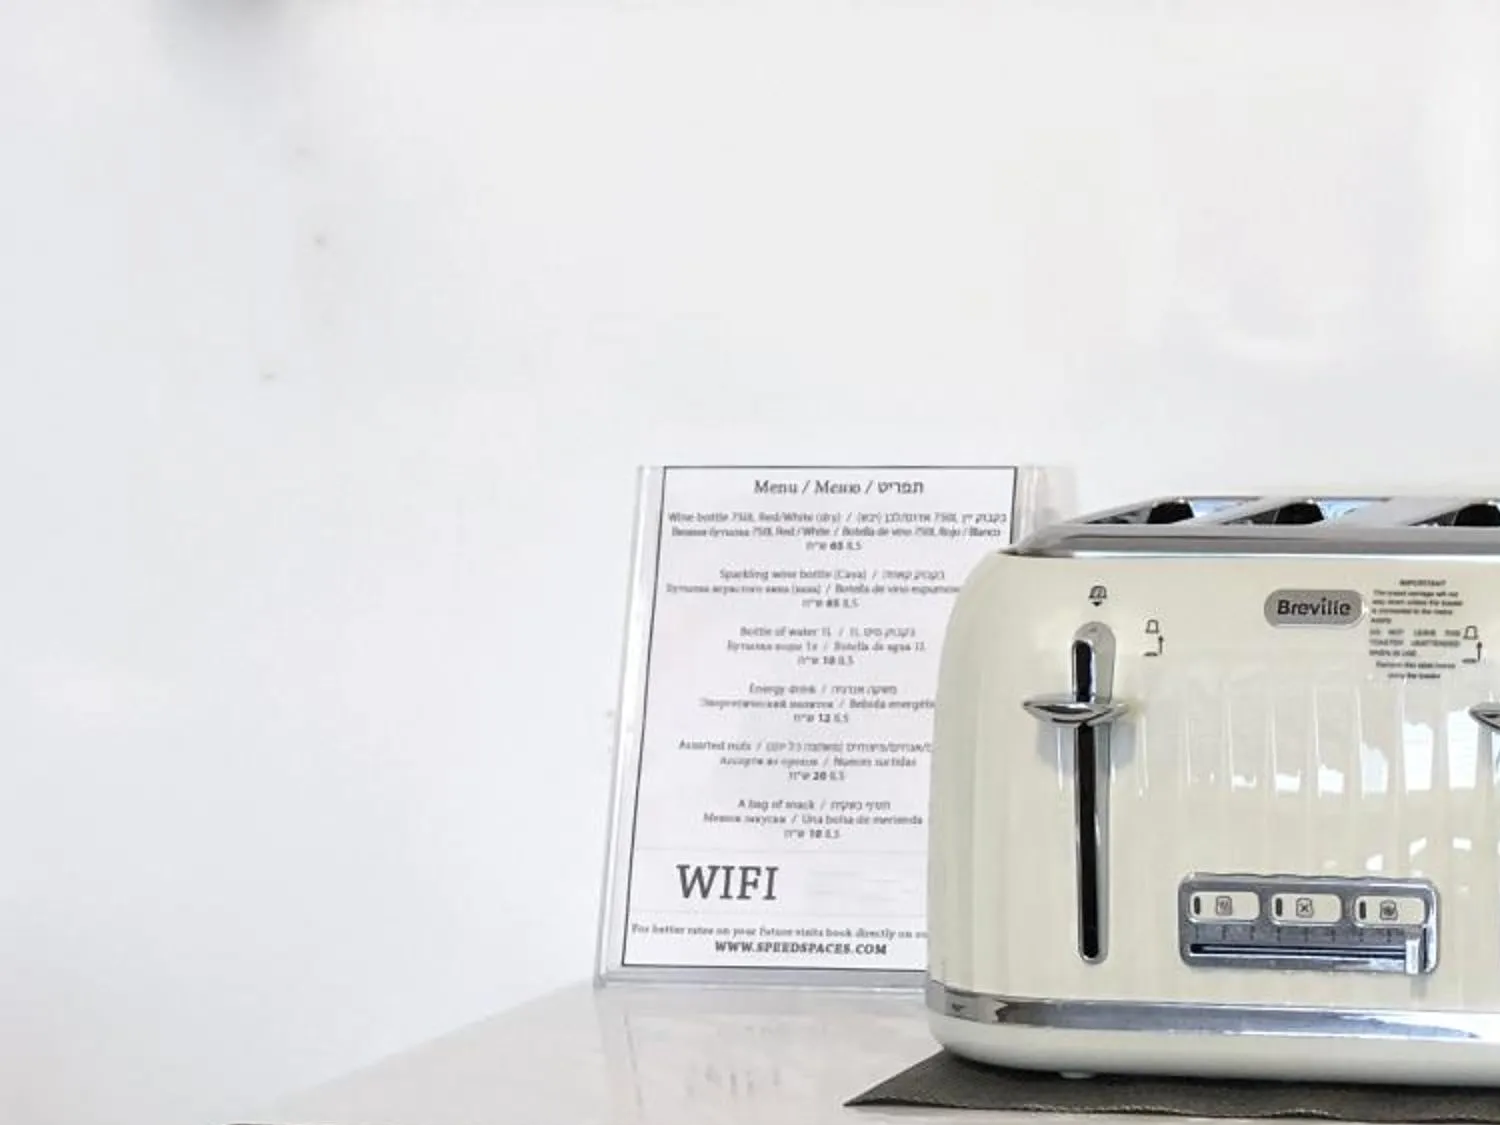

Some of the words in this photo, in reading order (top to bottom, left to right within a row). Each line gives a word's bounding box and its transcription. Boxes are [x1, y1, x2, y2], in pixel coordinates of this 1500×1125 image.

[754, 480, 798, 494] Menu
[814, 480, 861, 494] Меню
[877, 480, 924, 494] תפריט
[668, 512, 693, 523] Wine
[697, 512, 728, 523] bottle
[720, 569, 768, 580] Sparkling
[800, 569, 831, 579] bottle
[1277, 598, 1351, 615] Breville
[740, 627, 771, 637] Bottle
[789, 627, 817, 637] water
[748, 800, 768, 812] bag
[785, 800, 815, 809] snack
[676, 864, 779, 900] WIFI
[632, 924, 649, 933] For
[652, 924, 684, 934] better
[687, 926, 714, 935] rates
[733, 928, 757, 938] your
[826, 928, 851, 937] book
[855, 928, 896, 941] directly
[715, 941, 887, 955] WWW.SPEEDSPACES.COM
